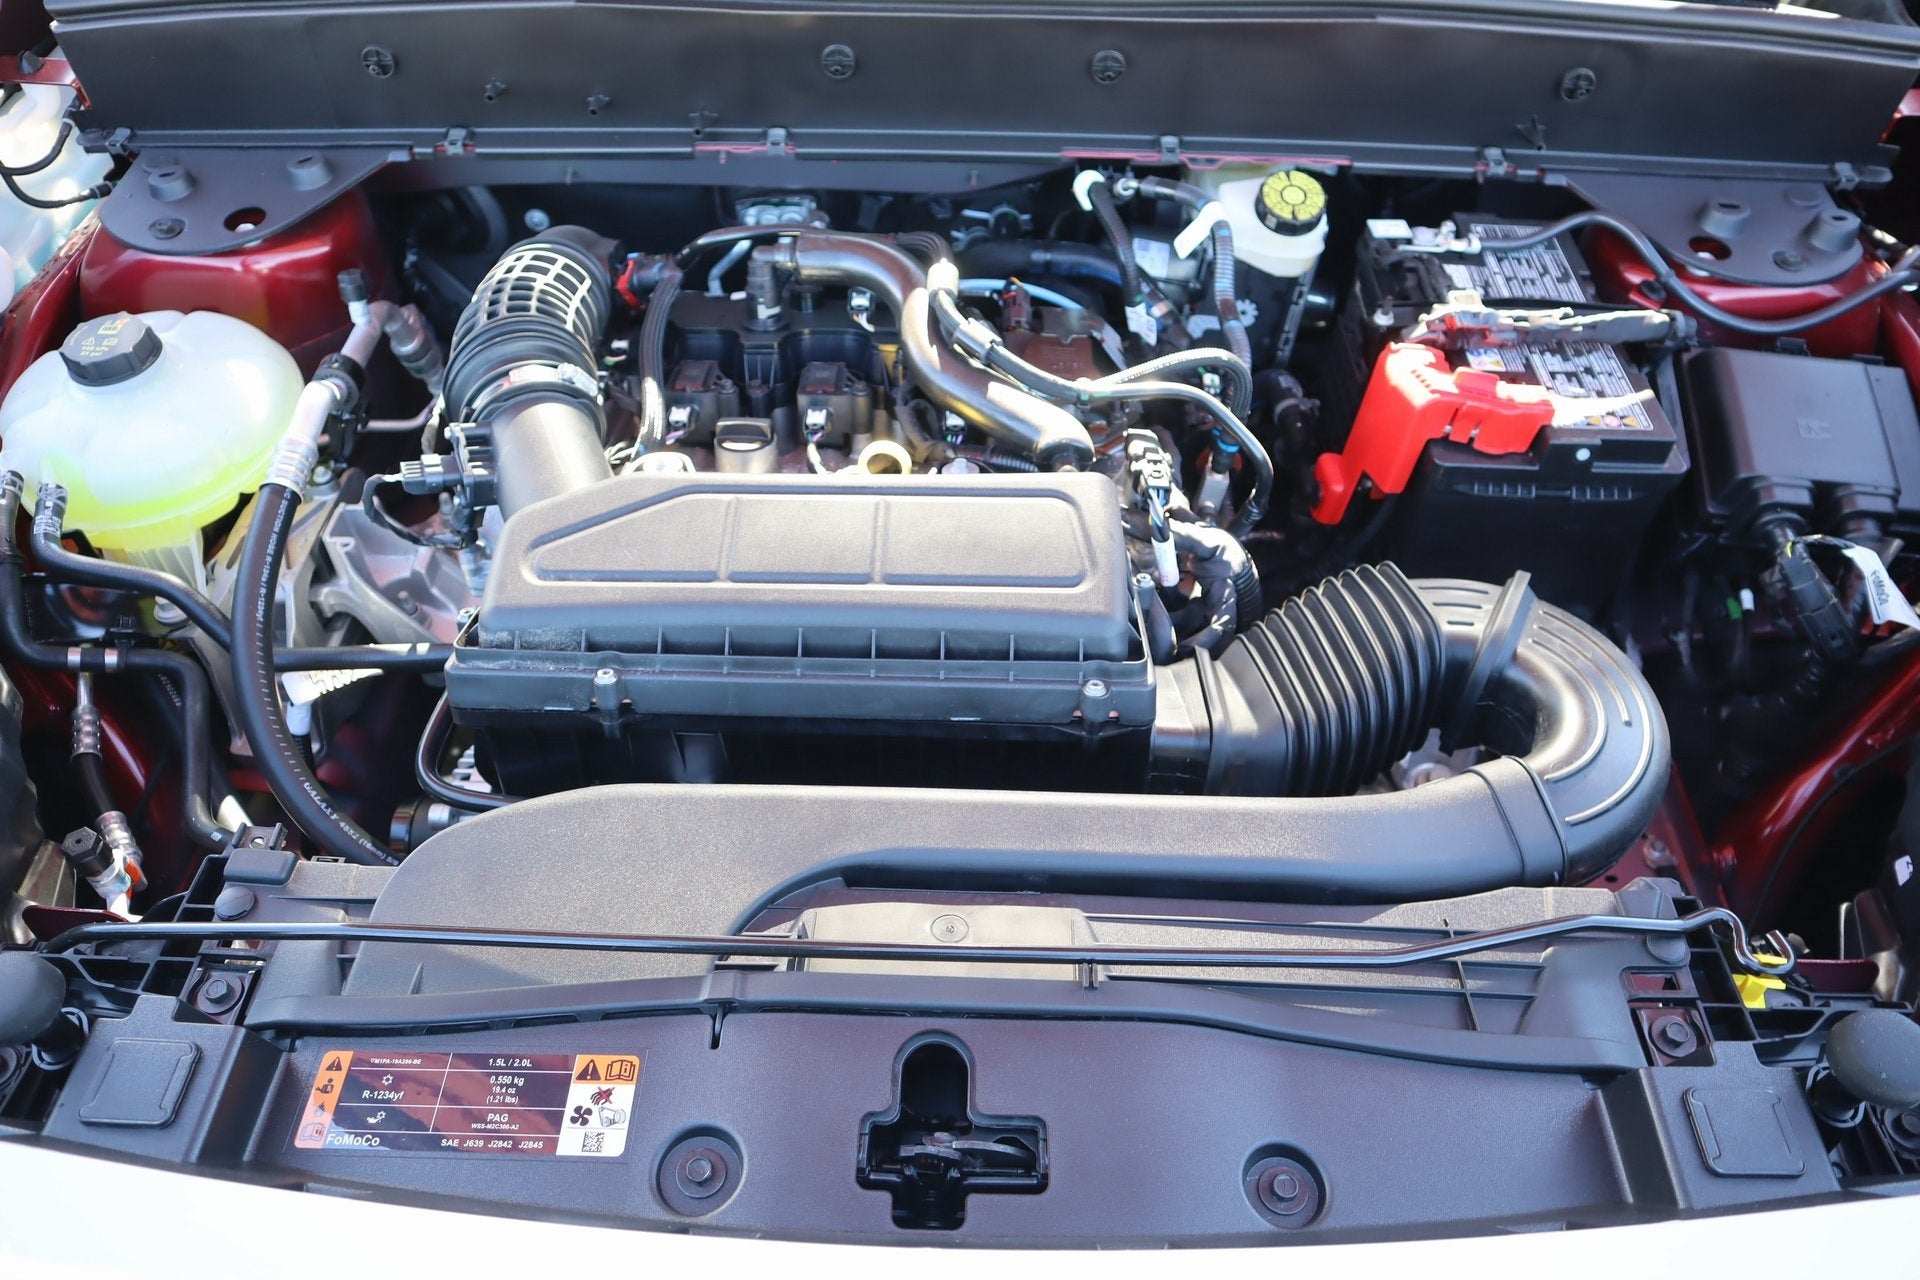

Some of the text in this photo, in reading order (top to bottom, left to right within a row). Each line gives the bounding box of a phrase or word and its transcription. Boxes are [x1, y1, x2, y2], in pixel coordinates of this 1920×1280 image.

[266, 532, 279, 556] HOSE
[303, 782, 339, 820] GALAXY
[489, 1058, 532, 1067] 1.5L / 2.0L
[490, 1075, 525, 1087] 0.550 kg
[492, 1086, 507, 1094] 19.4
[361, 1090, 404, 1101] R-1234yf
[486, 1095, 519, 1105] (1.21 lbs)
[486, 1113, 509, 1122] PAG
[325, 1133, 380, 1147] FoMoCo
[440, 1139, 544, 1149] SAE J639 J2842 J2845
